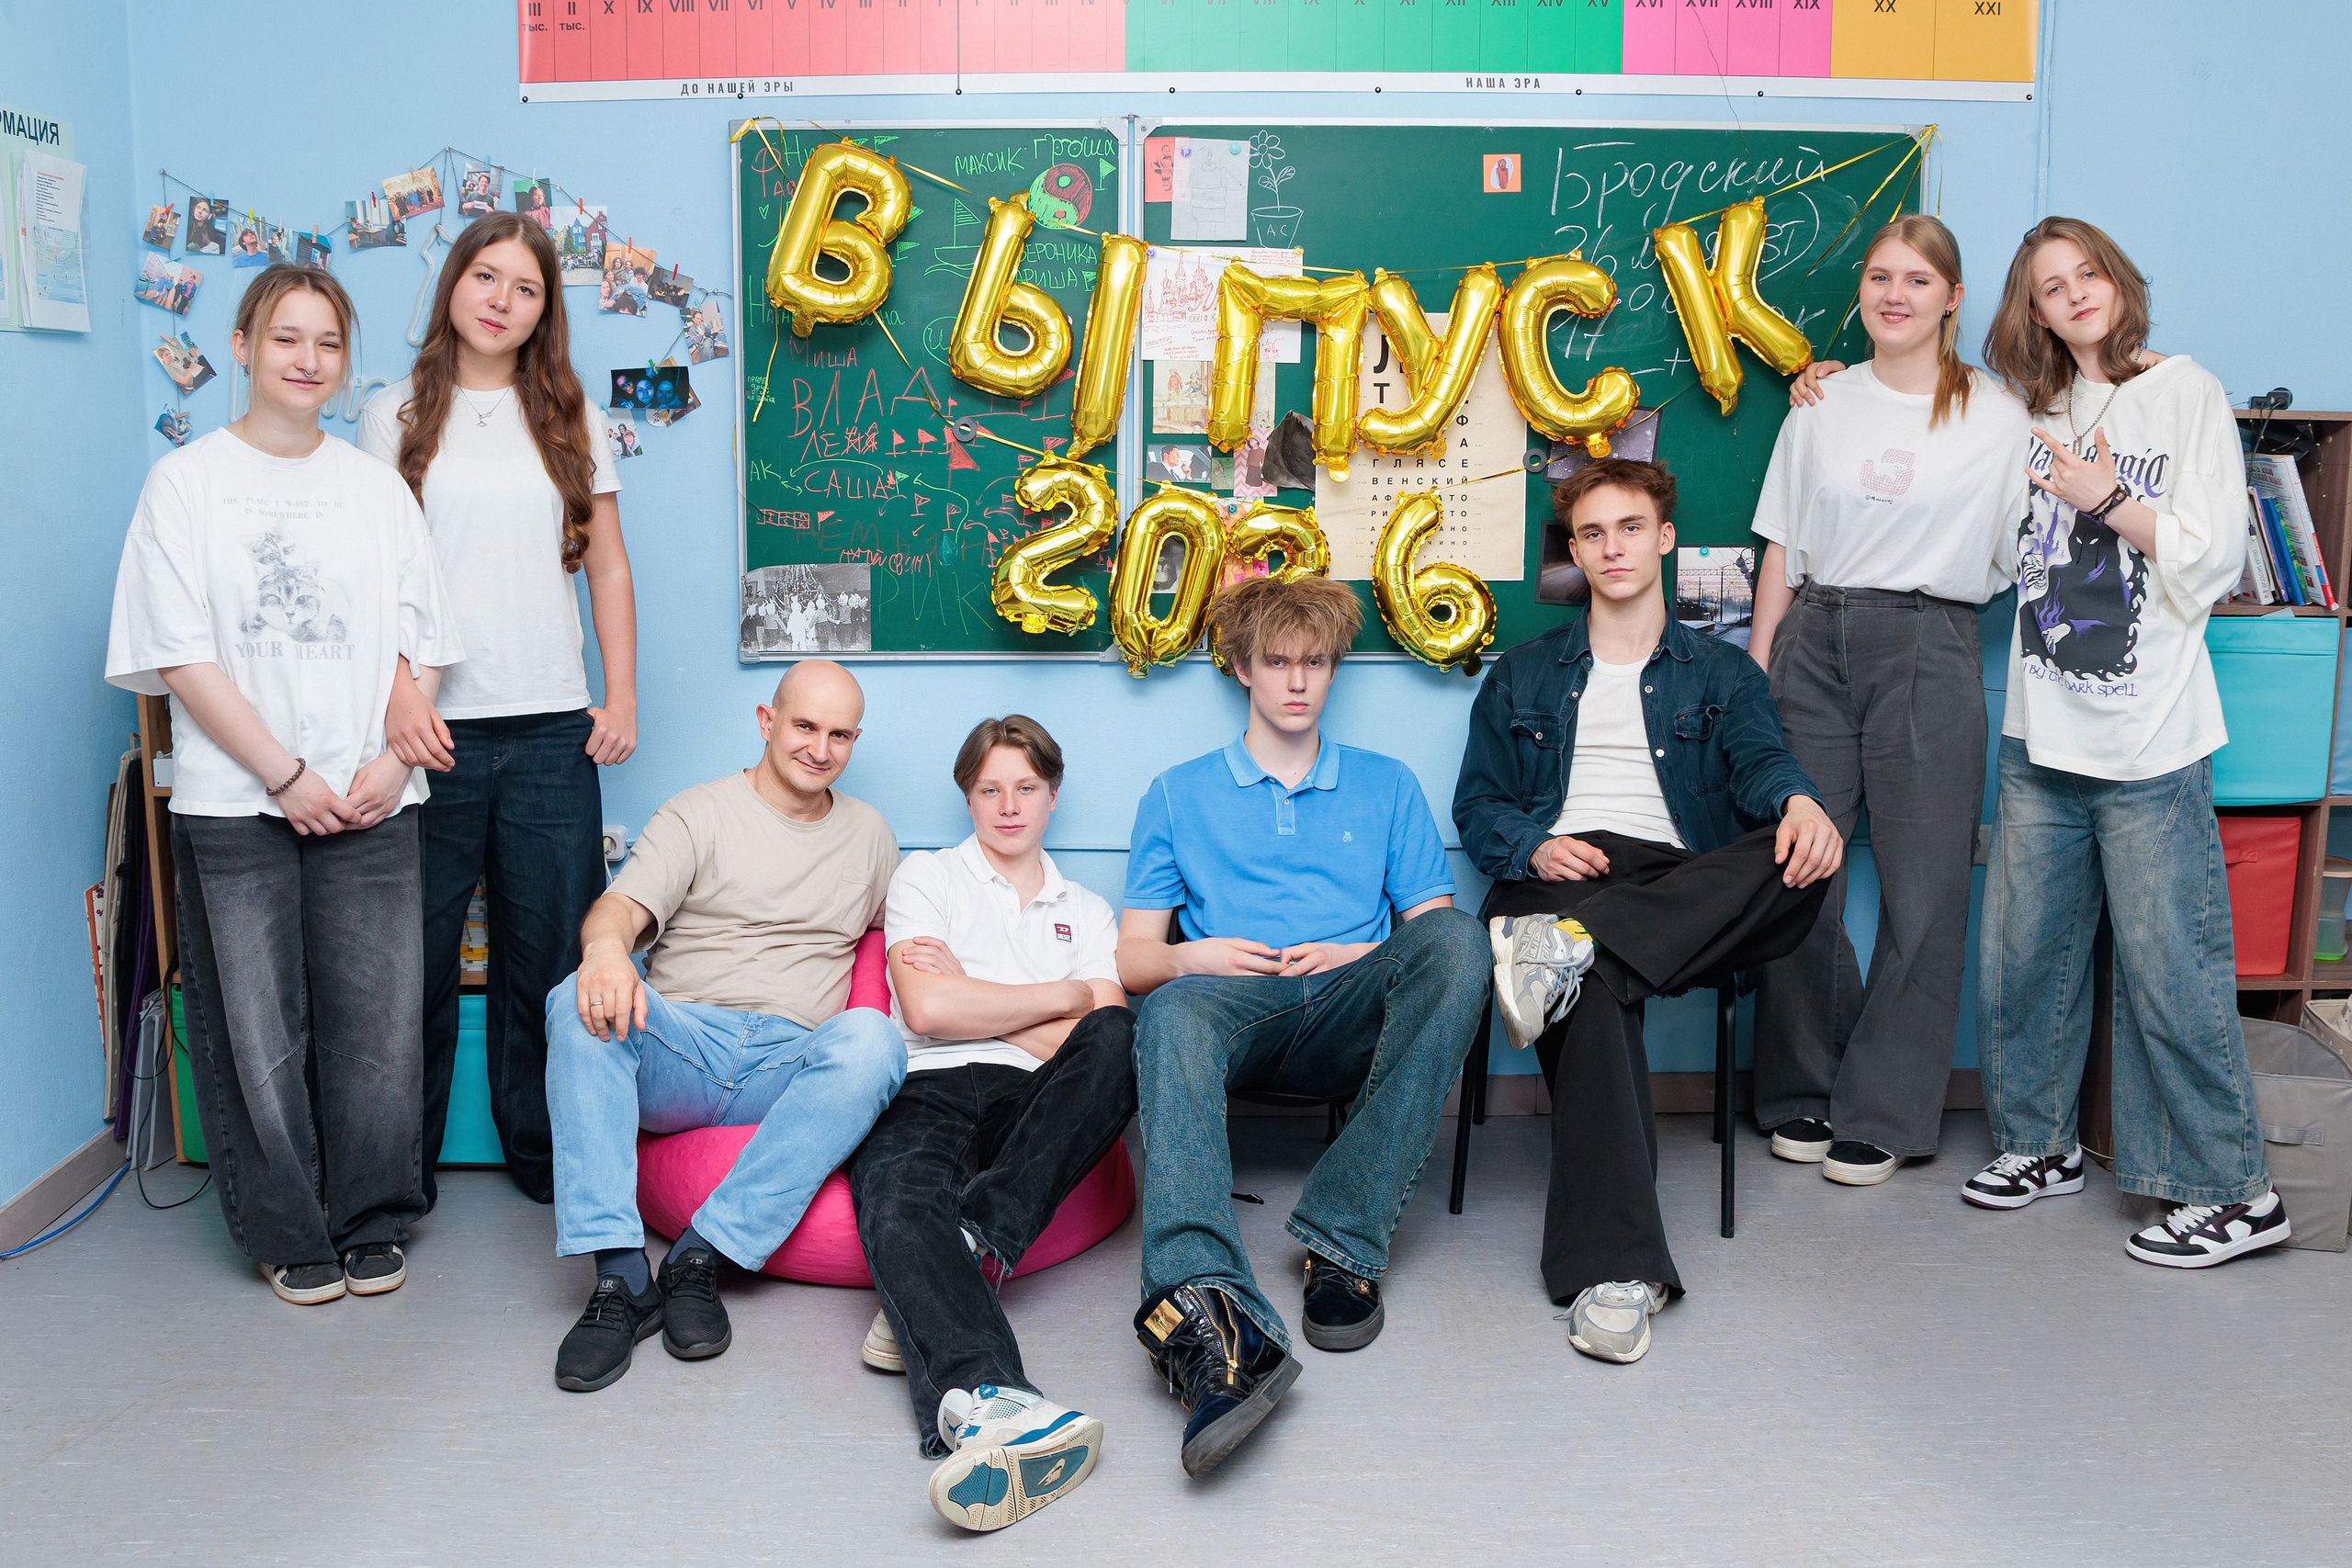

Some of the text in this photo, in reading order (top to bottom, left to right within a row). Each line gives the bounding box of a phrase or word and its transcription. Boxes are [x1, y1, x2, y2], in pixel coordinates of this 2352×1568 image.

[528, 3, 541, 16] III
[568, 2, 576, 15] II
[603, 1, 615, 14] X
[638, 0, 653, 13] IX
[670, 0, 695, 12] VIII
[708, 0, 729, 11] VII
[748, 0, 763, 10] VI
[1792, 0, 1821, 9] XIX
[1873, 0, 1896, 13] XX
[1973, 2, 2001, 16] XXI
[681, 80, 793, 96] ДО НАШЕЙ ЭРЫ
[1466, 77, 1541, 89] НАША ЭРА
[0, 109, 60, 146] МАЦИЯ
[1551, 141, 1826, 229] Бродский
[766, 140, 1815, 476] ВЫПУСК
[787, 367, 944, 438] ВЛАД
[1373, 458, 1468, 468] ГЛЯСЕ
[1373, 476, 1468, 485] ВЕНСКИЙ
[245, 497, 269, 506] PLACE
[258, 509, 309, 519] SOMEWHERE
[991, 454, 1497, 678] 2026
[234, 640, 356, 660] YOUR HEART
